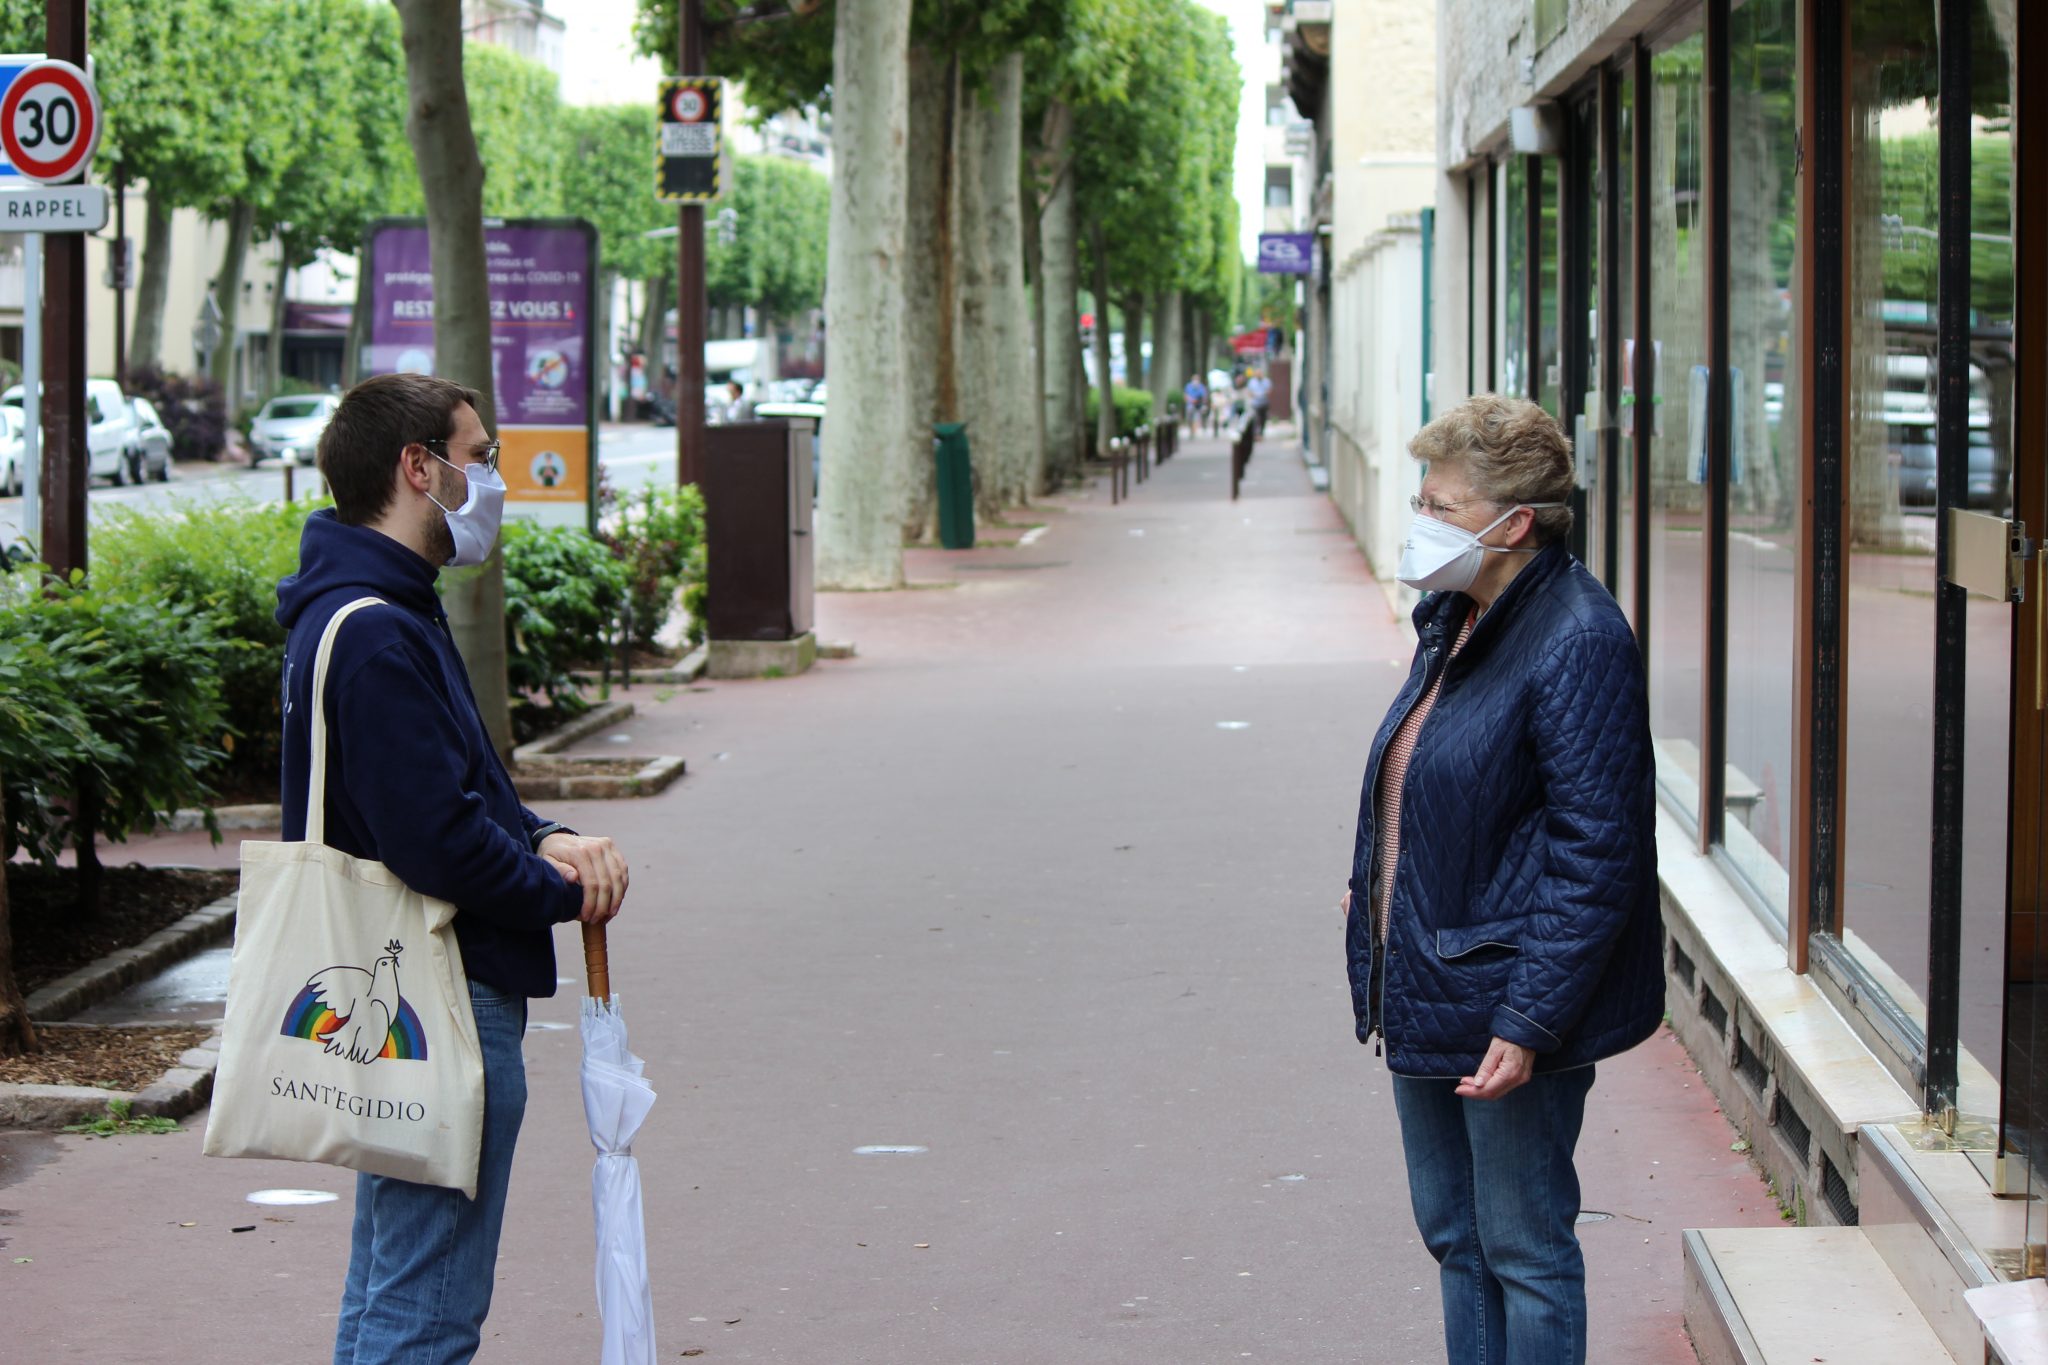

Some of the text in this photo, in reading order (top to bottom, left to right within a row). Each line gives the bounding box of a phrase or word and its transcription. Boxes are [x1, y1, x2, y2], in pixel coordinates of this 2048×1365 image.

[19, 95, 77, 149] 30
[8, 199, 86, 218] RAPPEL
[393, 300, 434, 318] REST
[508, 300, 561, 319] VOUS
[270, 1076, 425, 1122] SANT'EGIDIO
